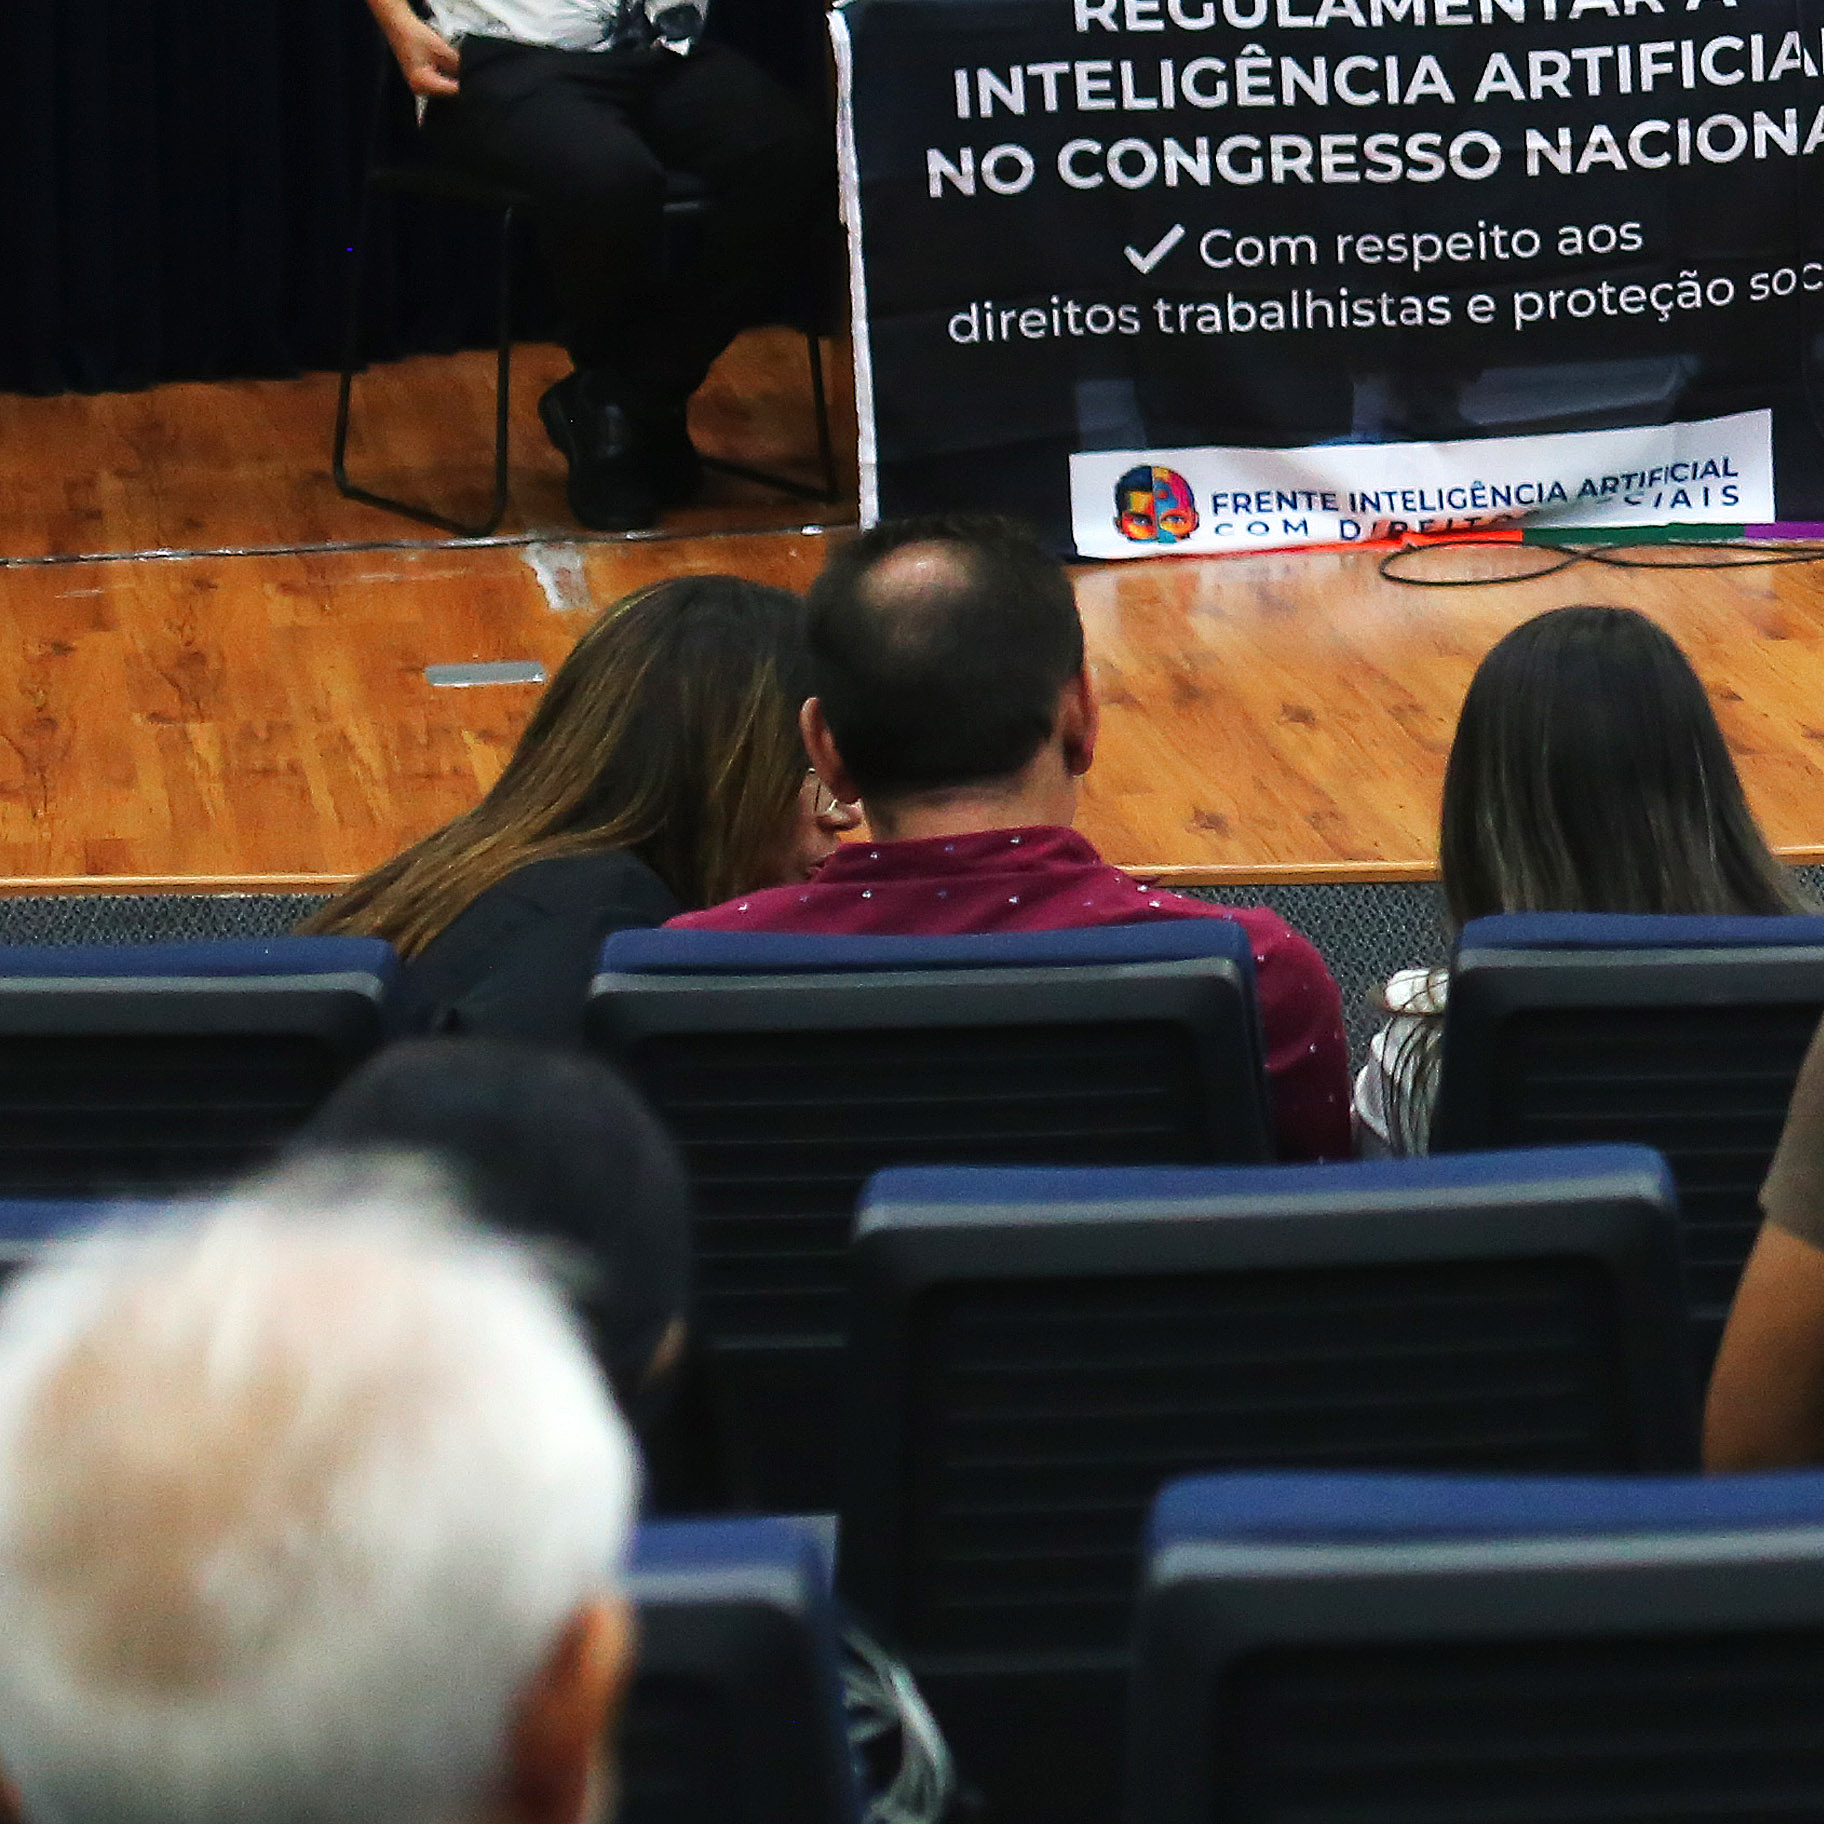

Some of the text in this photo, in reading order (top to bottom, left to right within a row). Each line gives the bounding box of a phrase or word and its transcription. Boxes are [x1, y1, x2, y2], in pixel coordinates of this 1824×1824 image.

[953, 45, 1454, 118] INTELIGÊNCIA
[926, 141, 1034, 198] NO
[1057, 129, 1502, 189] CONGRESSO
[1200, 219, 1644, 275] Com respeito aos
[949, 296, 1140, 344] direitos
[1153, 287, 1452, 336] trabalhistas
[1466, 290, 1498, 326] e
[1513, 270, 1736, 330] proteção
[1211, 457, 1739, 518] FRENTE INTELIGÊNCIA ARTIFICIAL
[1213, 518, 1310, 538] COM
